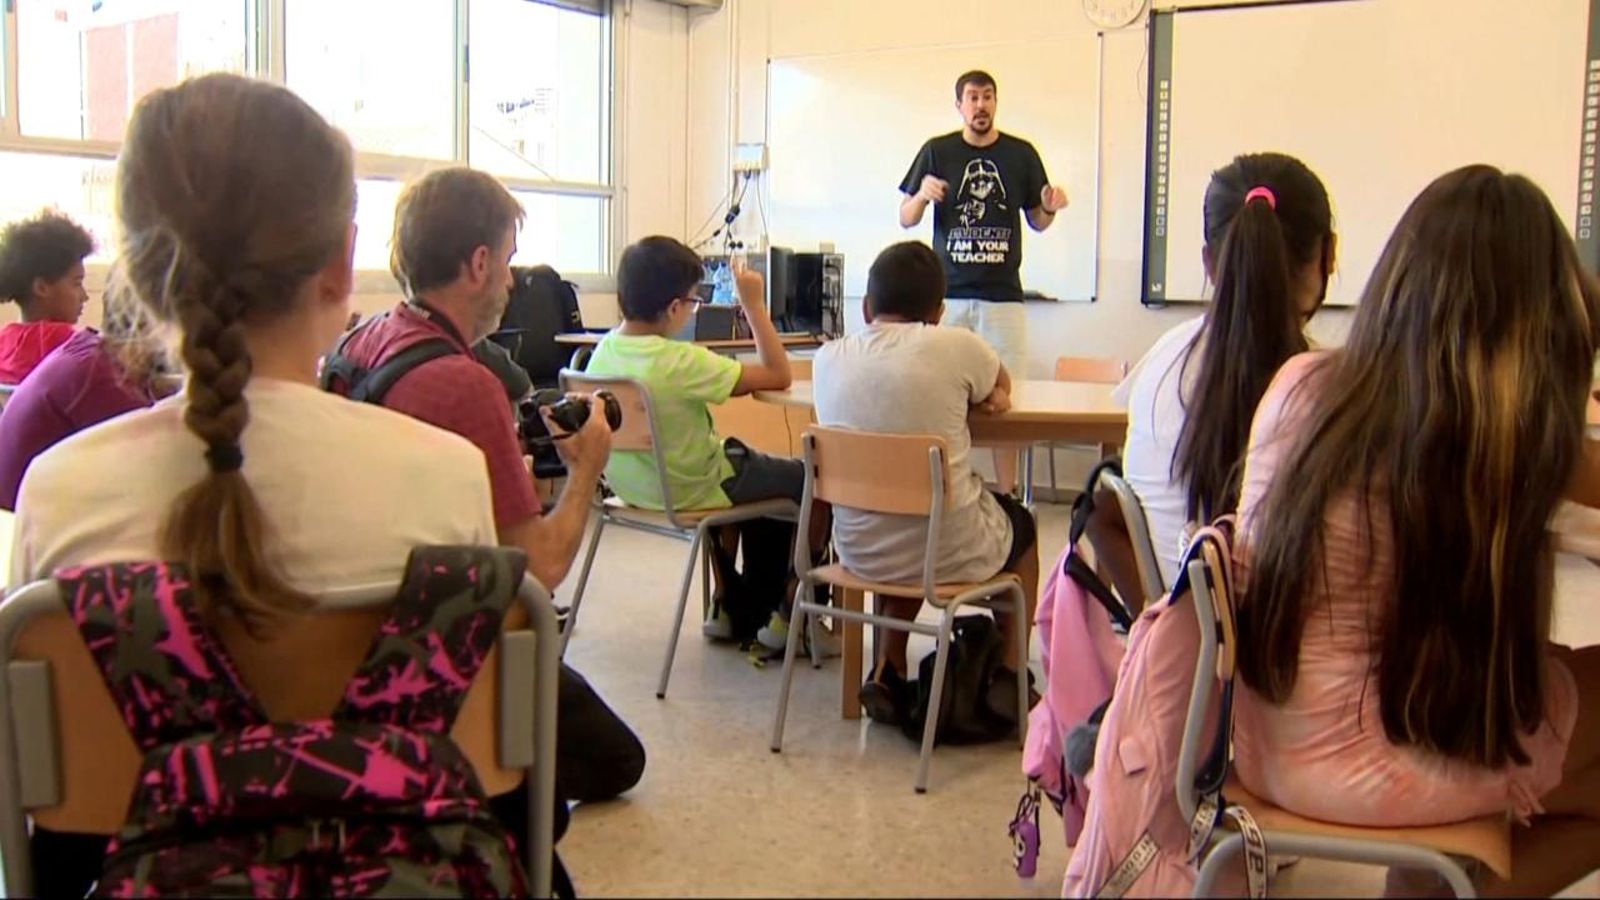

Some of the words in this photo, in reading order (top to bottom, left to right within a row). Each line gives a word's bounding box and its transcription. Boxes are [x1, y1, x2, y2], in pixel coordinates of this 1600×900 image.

[946, 240, 951, 251] I
[954, 240, 972, 251] AM
[976, 240, 1009, 252] YOUR
[951, 252, 1005, 263] TEACHER
